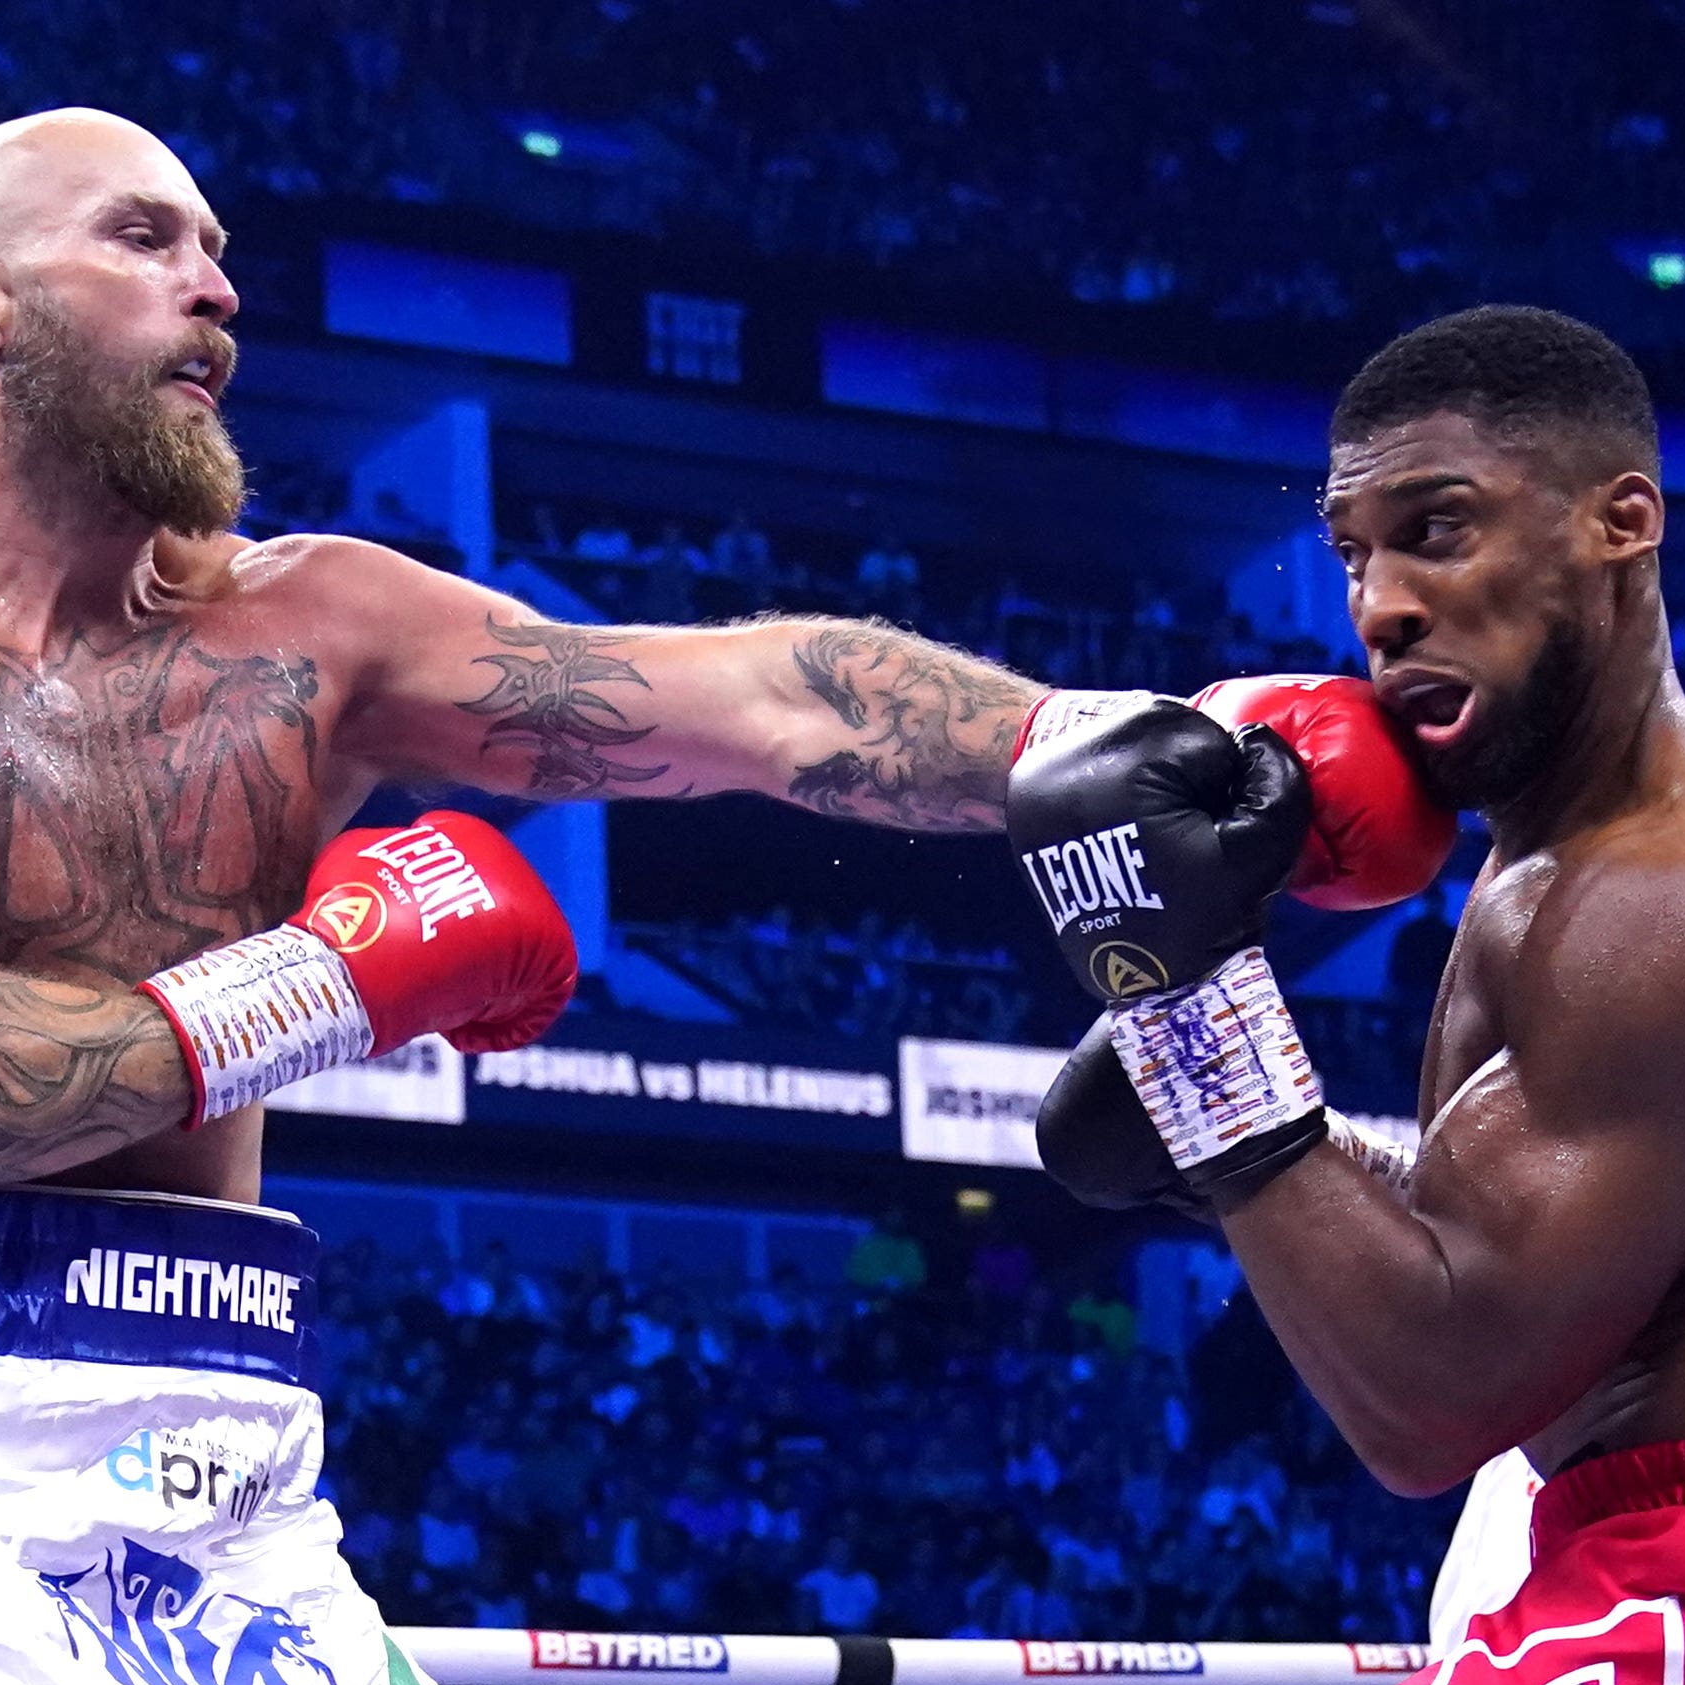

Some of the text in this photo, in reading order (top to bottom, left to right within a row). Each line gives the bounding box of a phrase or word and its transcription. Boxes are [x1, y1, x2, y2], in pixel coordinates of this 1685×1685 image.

[357, 826, 496, 942] LEONE
[377, 868, 412, 907] SPORT
[1022, 822, 1164, 936] LEONE
[1078, 911, 1122, 934] SPORT
[475, 1046, 639, 1097] JOSHUA
[698, 1061, 892, 1117] HELENIUS
[65, 1248, 302, 1333] NIGHTMARE
[536, 1632, 725, 1671] BETFRED
[1026, 1642, 1202, 1672] BETFRED
